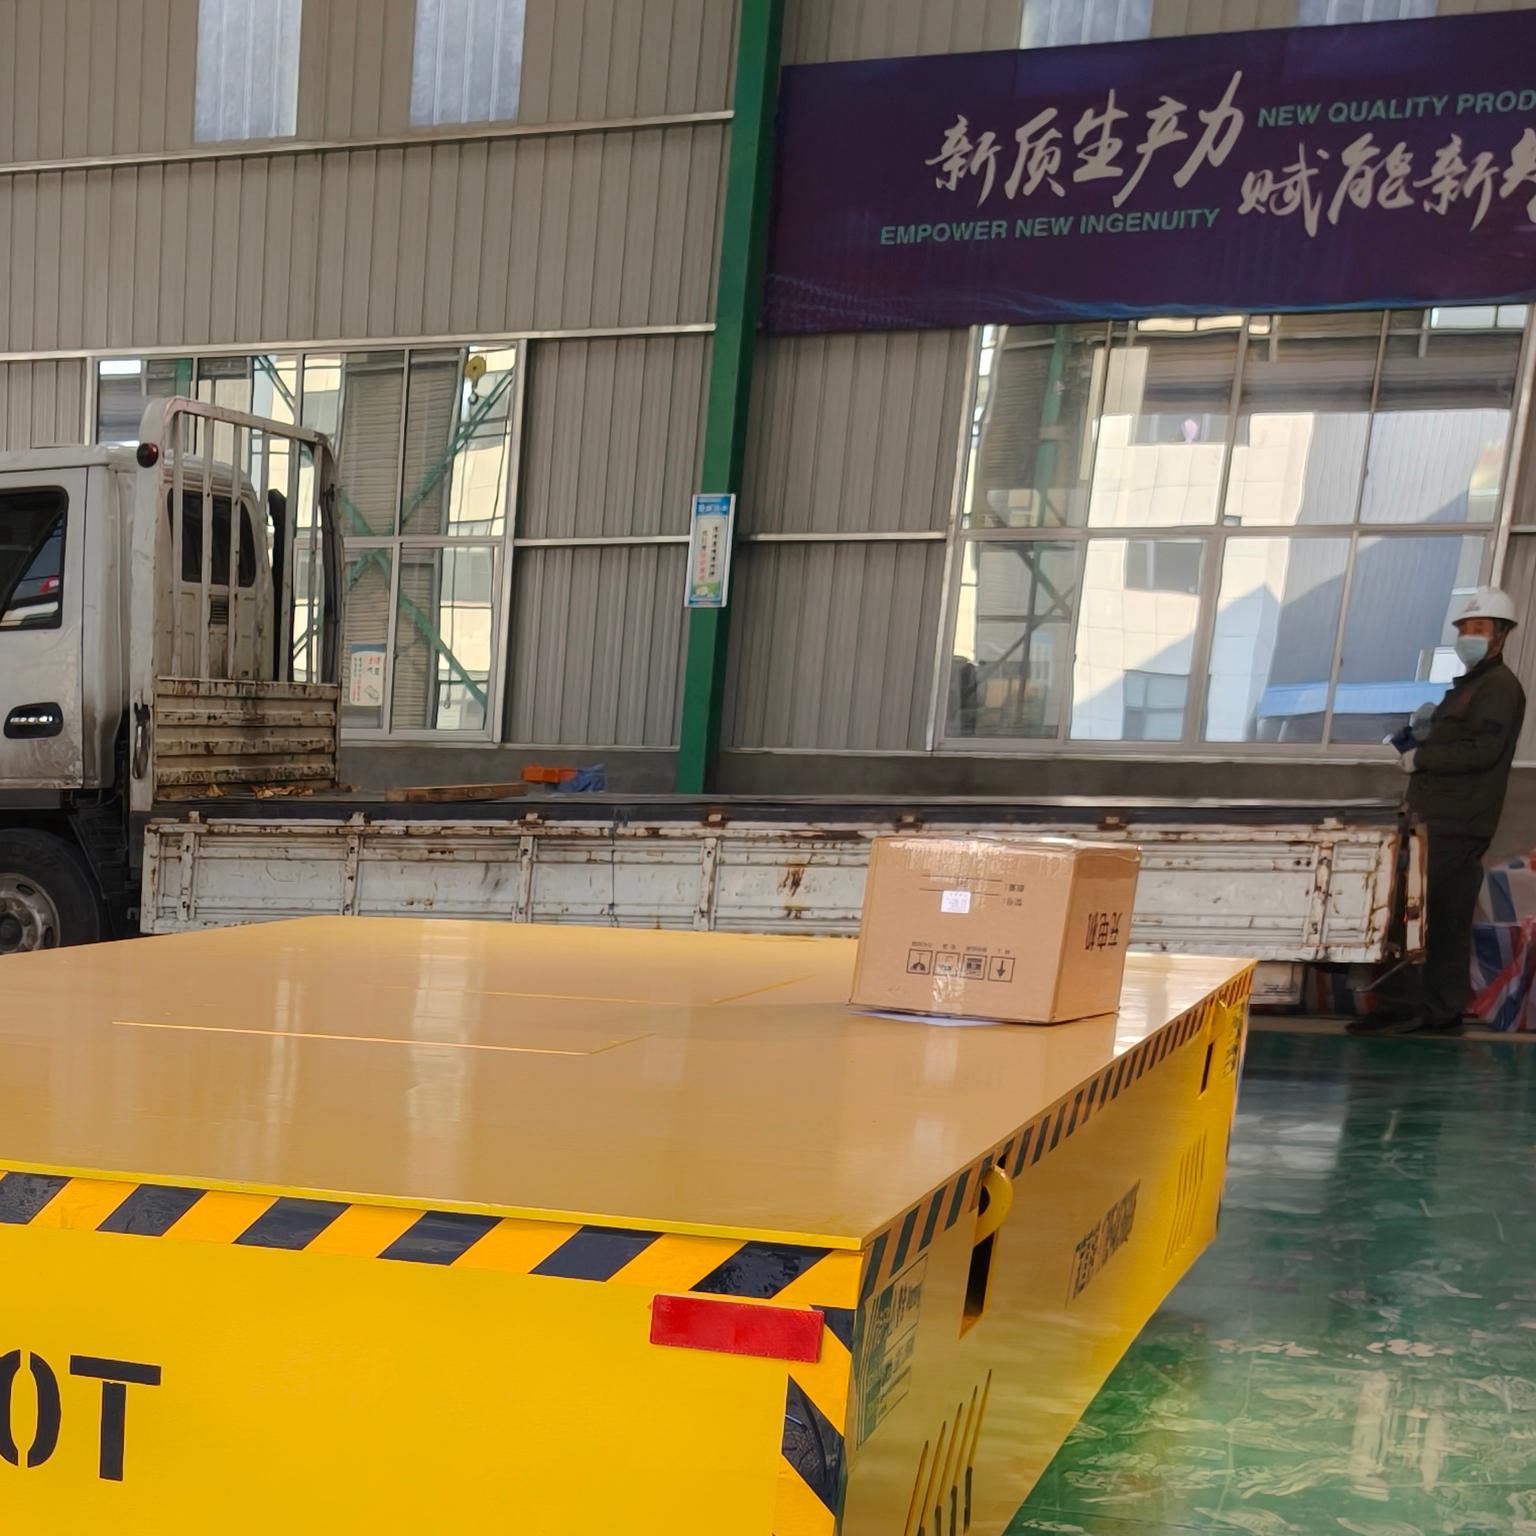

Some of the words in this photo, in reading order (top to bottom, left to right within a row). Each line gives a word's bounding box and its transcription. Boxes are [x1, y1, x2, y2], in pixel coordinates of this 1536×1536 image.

[1258, 104, 1322, 127] NEW
[1328, 96, 1447, 122] QUALITY
[924, 70, 1243, 208] 新质生产力
[880, 218, 1007, 246] EMPOWER
[1014, 214, 1074, 240] NEW
[1079, 208, 1220, 236] INGENUITY
